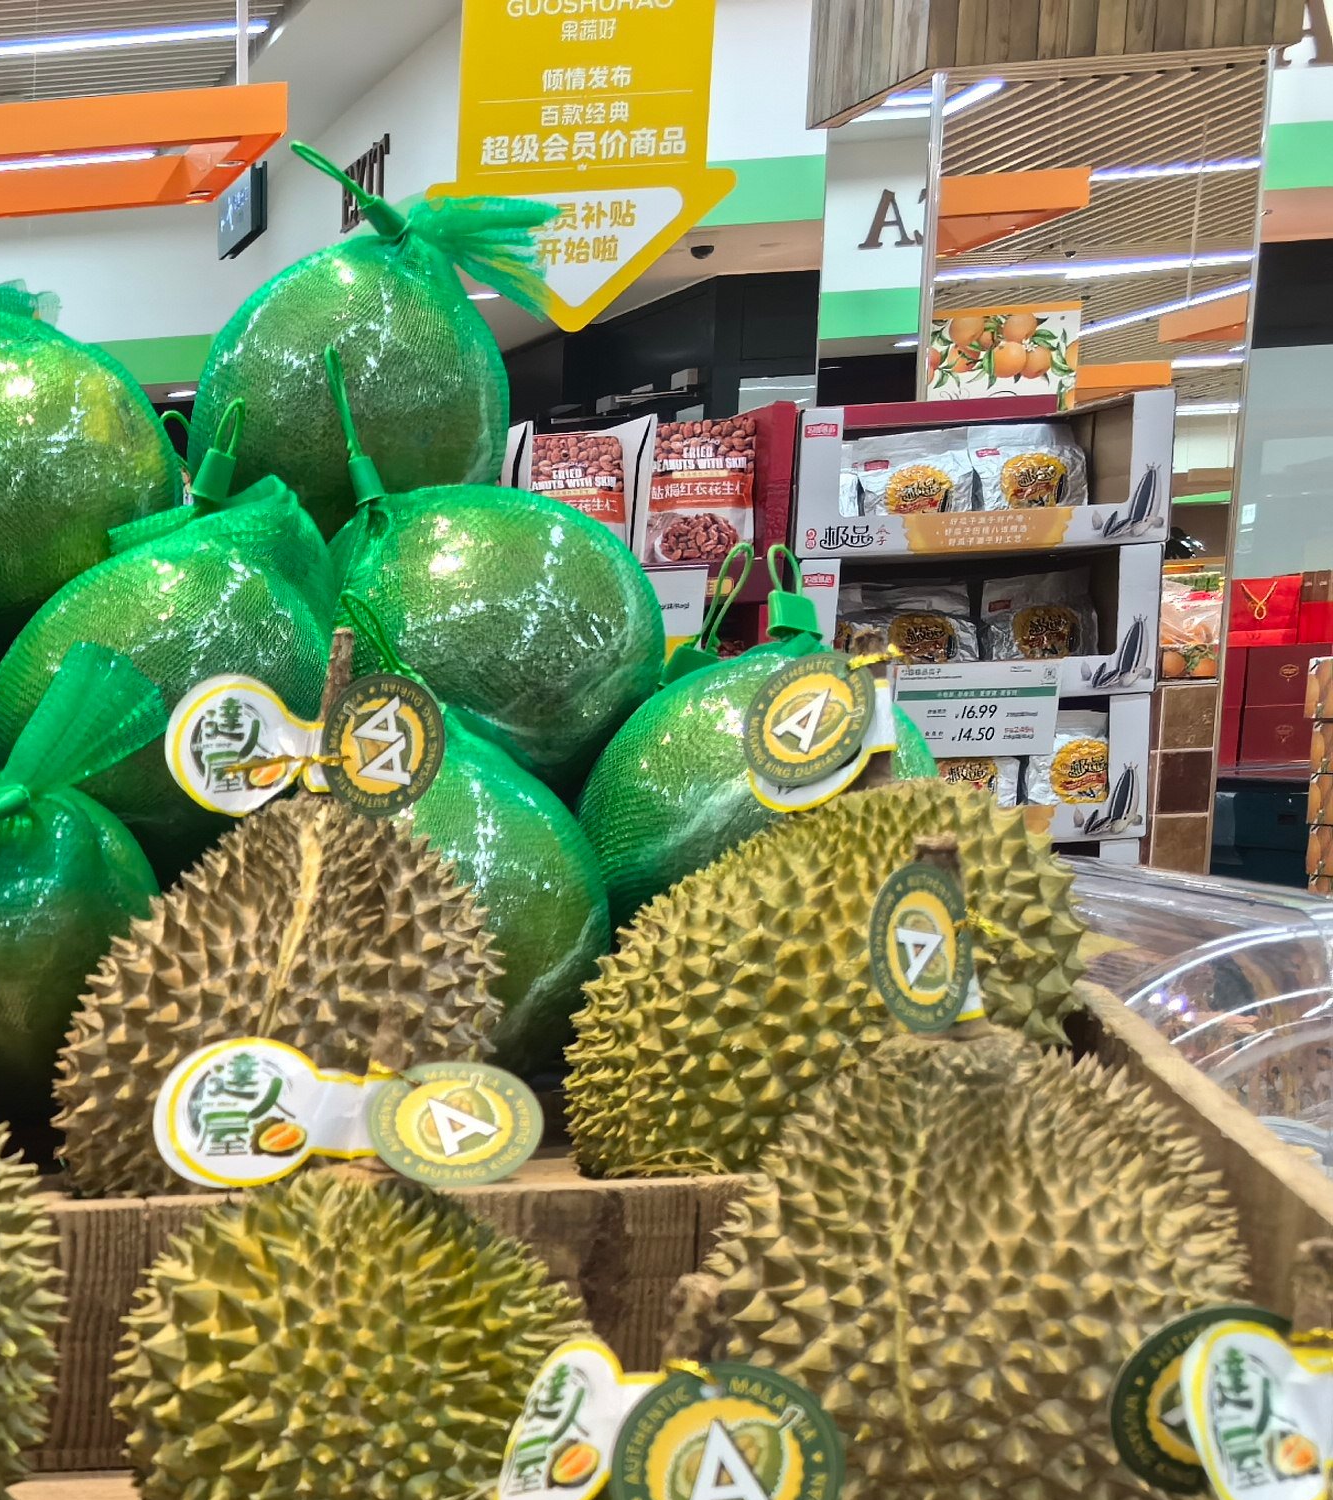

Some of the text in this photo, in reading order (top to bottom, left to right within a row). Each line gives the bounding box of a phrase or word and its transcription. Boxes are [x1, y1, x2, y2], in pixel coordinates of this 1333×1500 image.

[561, 17, 618, 42] 果蔬好
[542, 65, 632, 92] 倾情发布
[541, 100, 630, 127] 百款经典
[481, 127, 687, 166] 超级会员价商品
[530, 199, 637, 233] 员补贴
[536, 235, 619, 266] 开始啦
[682, 445, 714, 459] FRIED
[697, 456, 723, 470] WITH
[532, 477, 562, 491] ANUTS
[564, 476, 592, 489] WITH
[819, 524, 874, 551] 极品
[770, 687, 832, 754] A
[954, 704, 998, 720] ¥16.99
[352, 694, 411, 786] AA
[951, 726, 996, 742] ¥14.50
[427, 1096, 503, 1158] A
